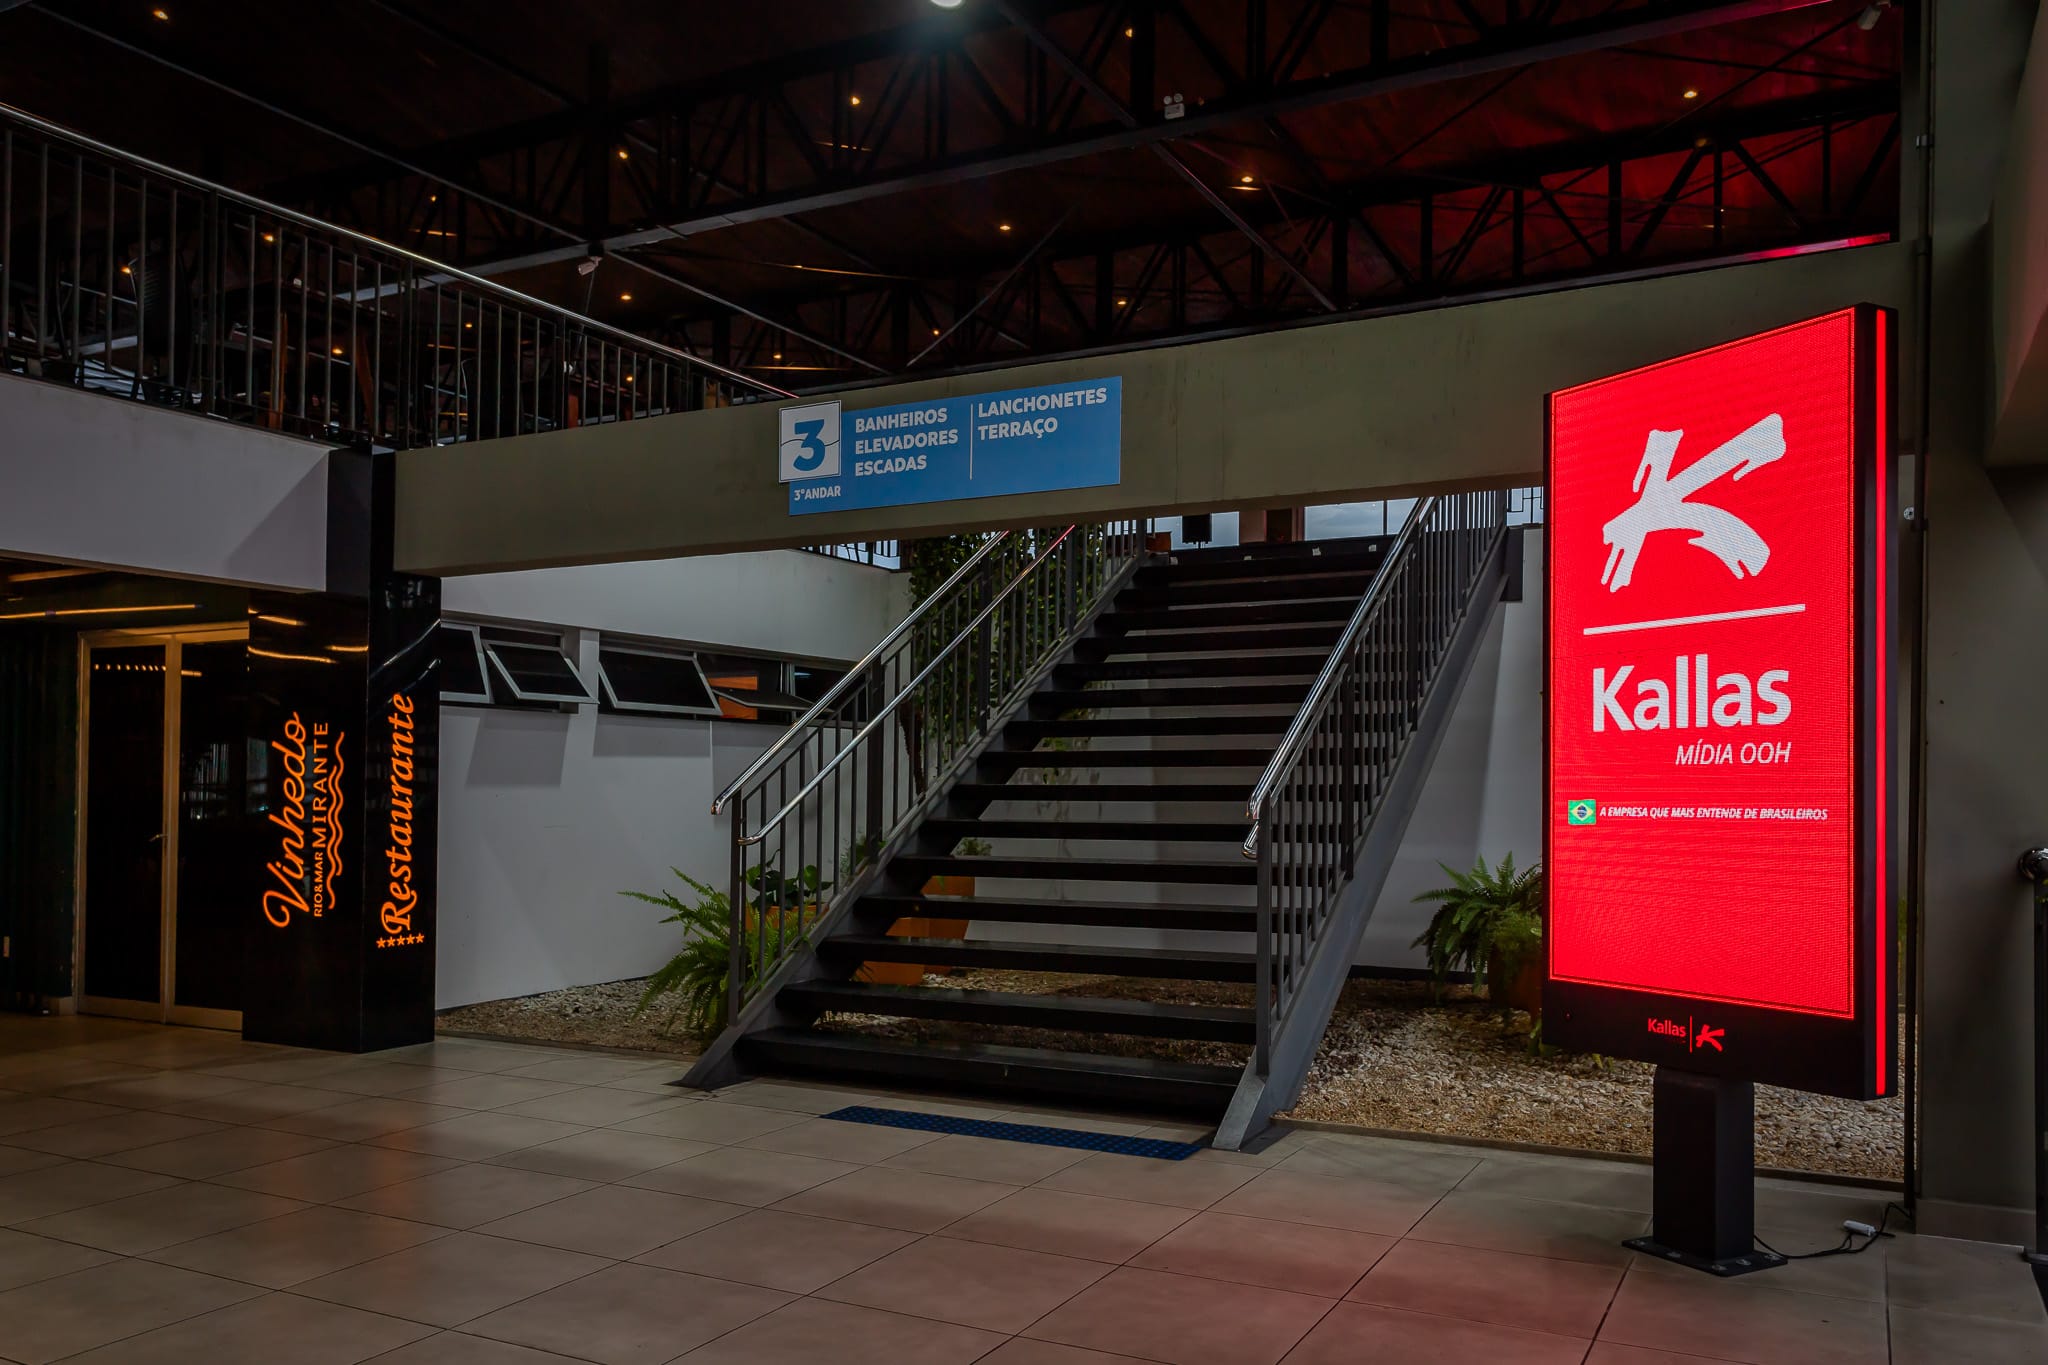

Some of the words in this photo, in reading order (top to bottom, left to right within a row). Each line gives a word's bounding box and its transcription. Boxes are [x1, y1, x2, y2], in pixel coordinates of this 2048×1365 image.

[978, 387, 1107, 418] LANCHONETES
[855, 407, 948, 434] BANHEIROS
[978, 417, 1058, 441] TERRAÇO
[793, 419, 825, 472] 3
[855, 429, 958, 455] ELEVADORES
[855, 454, 927, 477] ESCADAS
[1593, 653, 1792, 733] Kallas
[1675, 739, 1733, 766] MÍDIA
[1740, 741, 1792, 765] OOH
[312, 722, 328, 849] MIRANTE
[262, 711, 311, 928] Vinhedo
[380, 693, 418, 935] Restaurante
[1600, 807, 1607, 817] A
[1607, 807, 1648, 818] EMPRESA
[1650, 807, 1669, 819] QUE
[1670, 807, 1696, 819] MAIS
[1696, 807, 1742, 820] ENTENDE
[1744, 808, 1758, 820] DE
[1759, 808, 1829, 821] BRASILEIROS
[313, 851, 324, 917] RIO&MAR
[1647, 1017, 1687, 1038] Kallas
